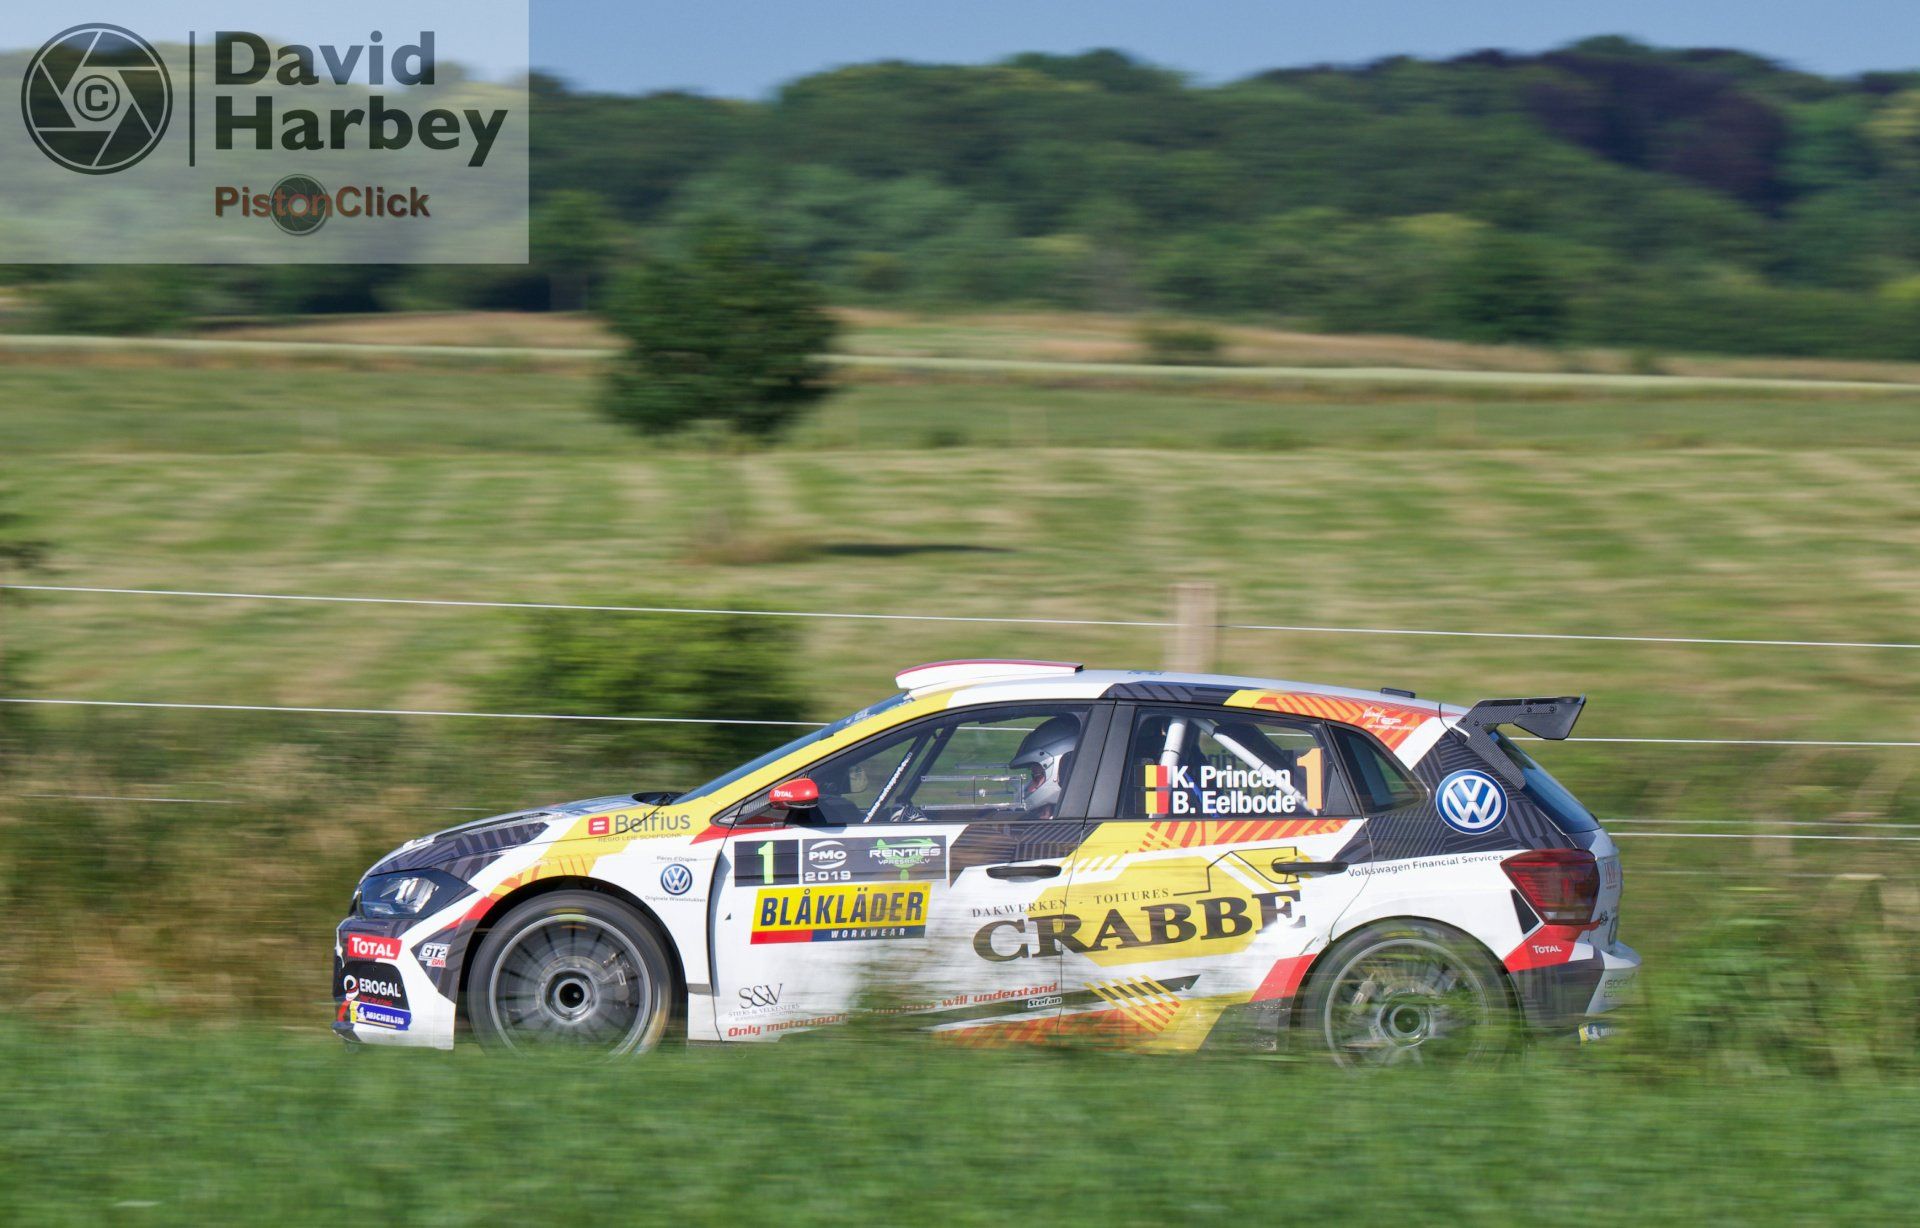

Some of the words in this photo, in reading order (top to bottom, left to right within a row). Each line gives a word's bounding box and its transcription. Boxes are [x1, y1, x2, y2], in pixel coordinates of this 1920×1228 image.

[1172, 765, 1194, 788] K.
[1200, 765, 1291, 788] Princen
[1296, 747, 1323, 810] 1
[1172, 791, 1196, 814] B.
[1202, 790, 1296, 814] Eelbode
[615, 812, 691, 834] Belfius
[757, 841, 774, 884] 1
[808, 850, 847, 861] PMO
[869, 848, 941, 858] RENTIES
[804, 870, 851, 882] 2019
[1348, 863, 1410, 877] Volkswagen
[1413, 858, 1459, 870] Financial
[1462, 854, 1504, 864] Services
[761, 888, 924, 927] BLÅKLÄDER
[972, 899, 1067, 918] DAKWERKEN
[1093, 888, 1170, 905] TOITURES
[831, 928, 905, 939] WORKWEAR
[972, 889, 1306, 962] CRABBE
[351, 937, 394, 957] TOTAL
[1532, 945, 1562, 954] TOTAL
[739, 983, 783, 1009] S&V
[942, 994, 968, 1006] will
[974, 982, 1058, 1003] understand
[1028, 997, 1062, 1008] Stefan
[728, 1023, 761, 1037] Only
